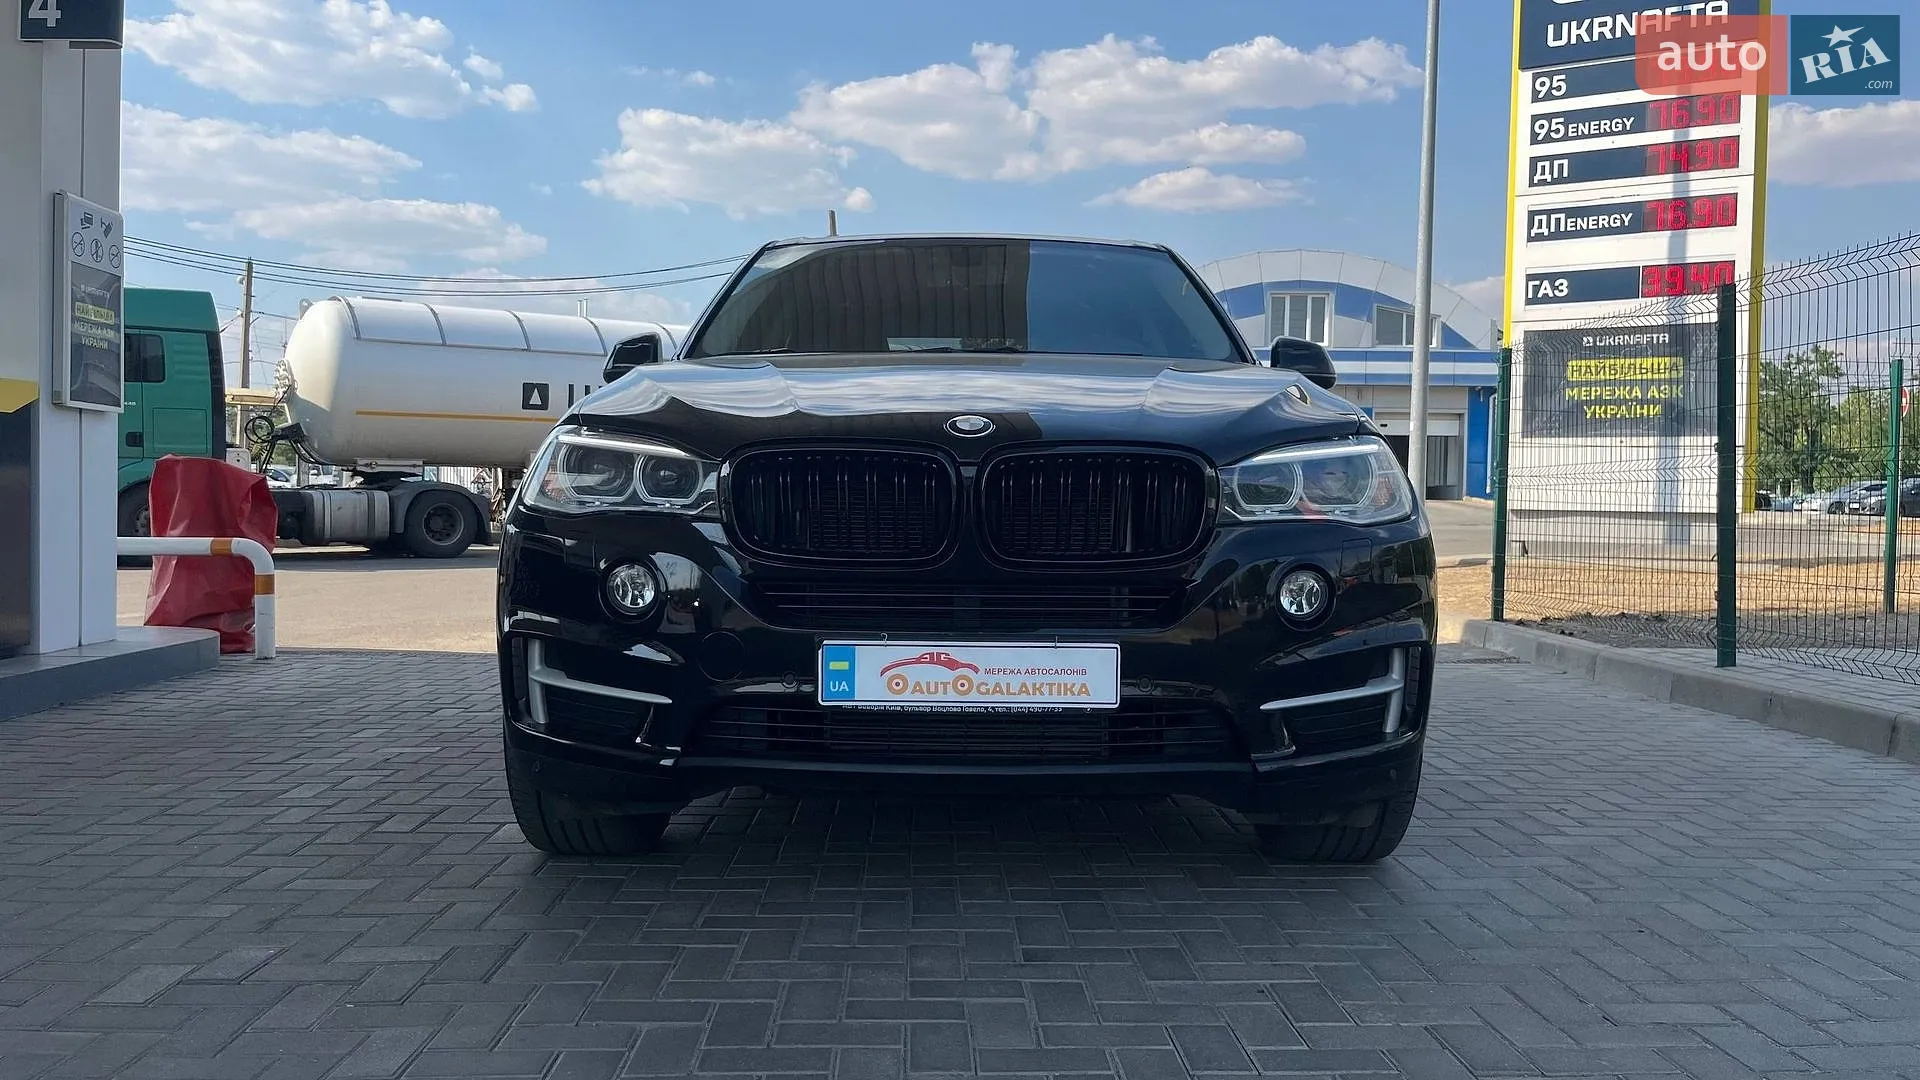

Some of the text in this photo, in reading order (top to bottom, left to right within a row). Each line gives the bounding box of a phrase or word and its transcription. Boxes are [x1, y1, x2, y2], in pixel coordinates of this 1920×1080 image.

[28, 0, 61, 27] 4
[1546, 0, 1729, 48] UKRNAFTA
[1534, 74, 1567, 99] 95
[1533, 117, 1635, 141] 95 ENERGY
[1533, 158, 1569, 184] ДП
[1527, 278, 1569, 299] ГАЗ
[984, 668, 1087, 676] МЕРЕЖА АВТОСАЛОНІВ
[829, 681, 849, 692] UA
